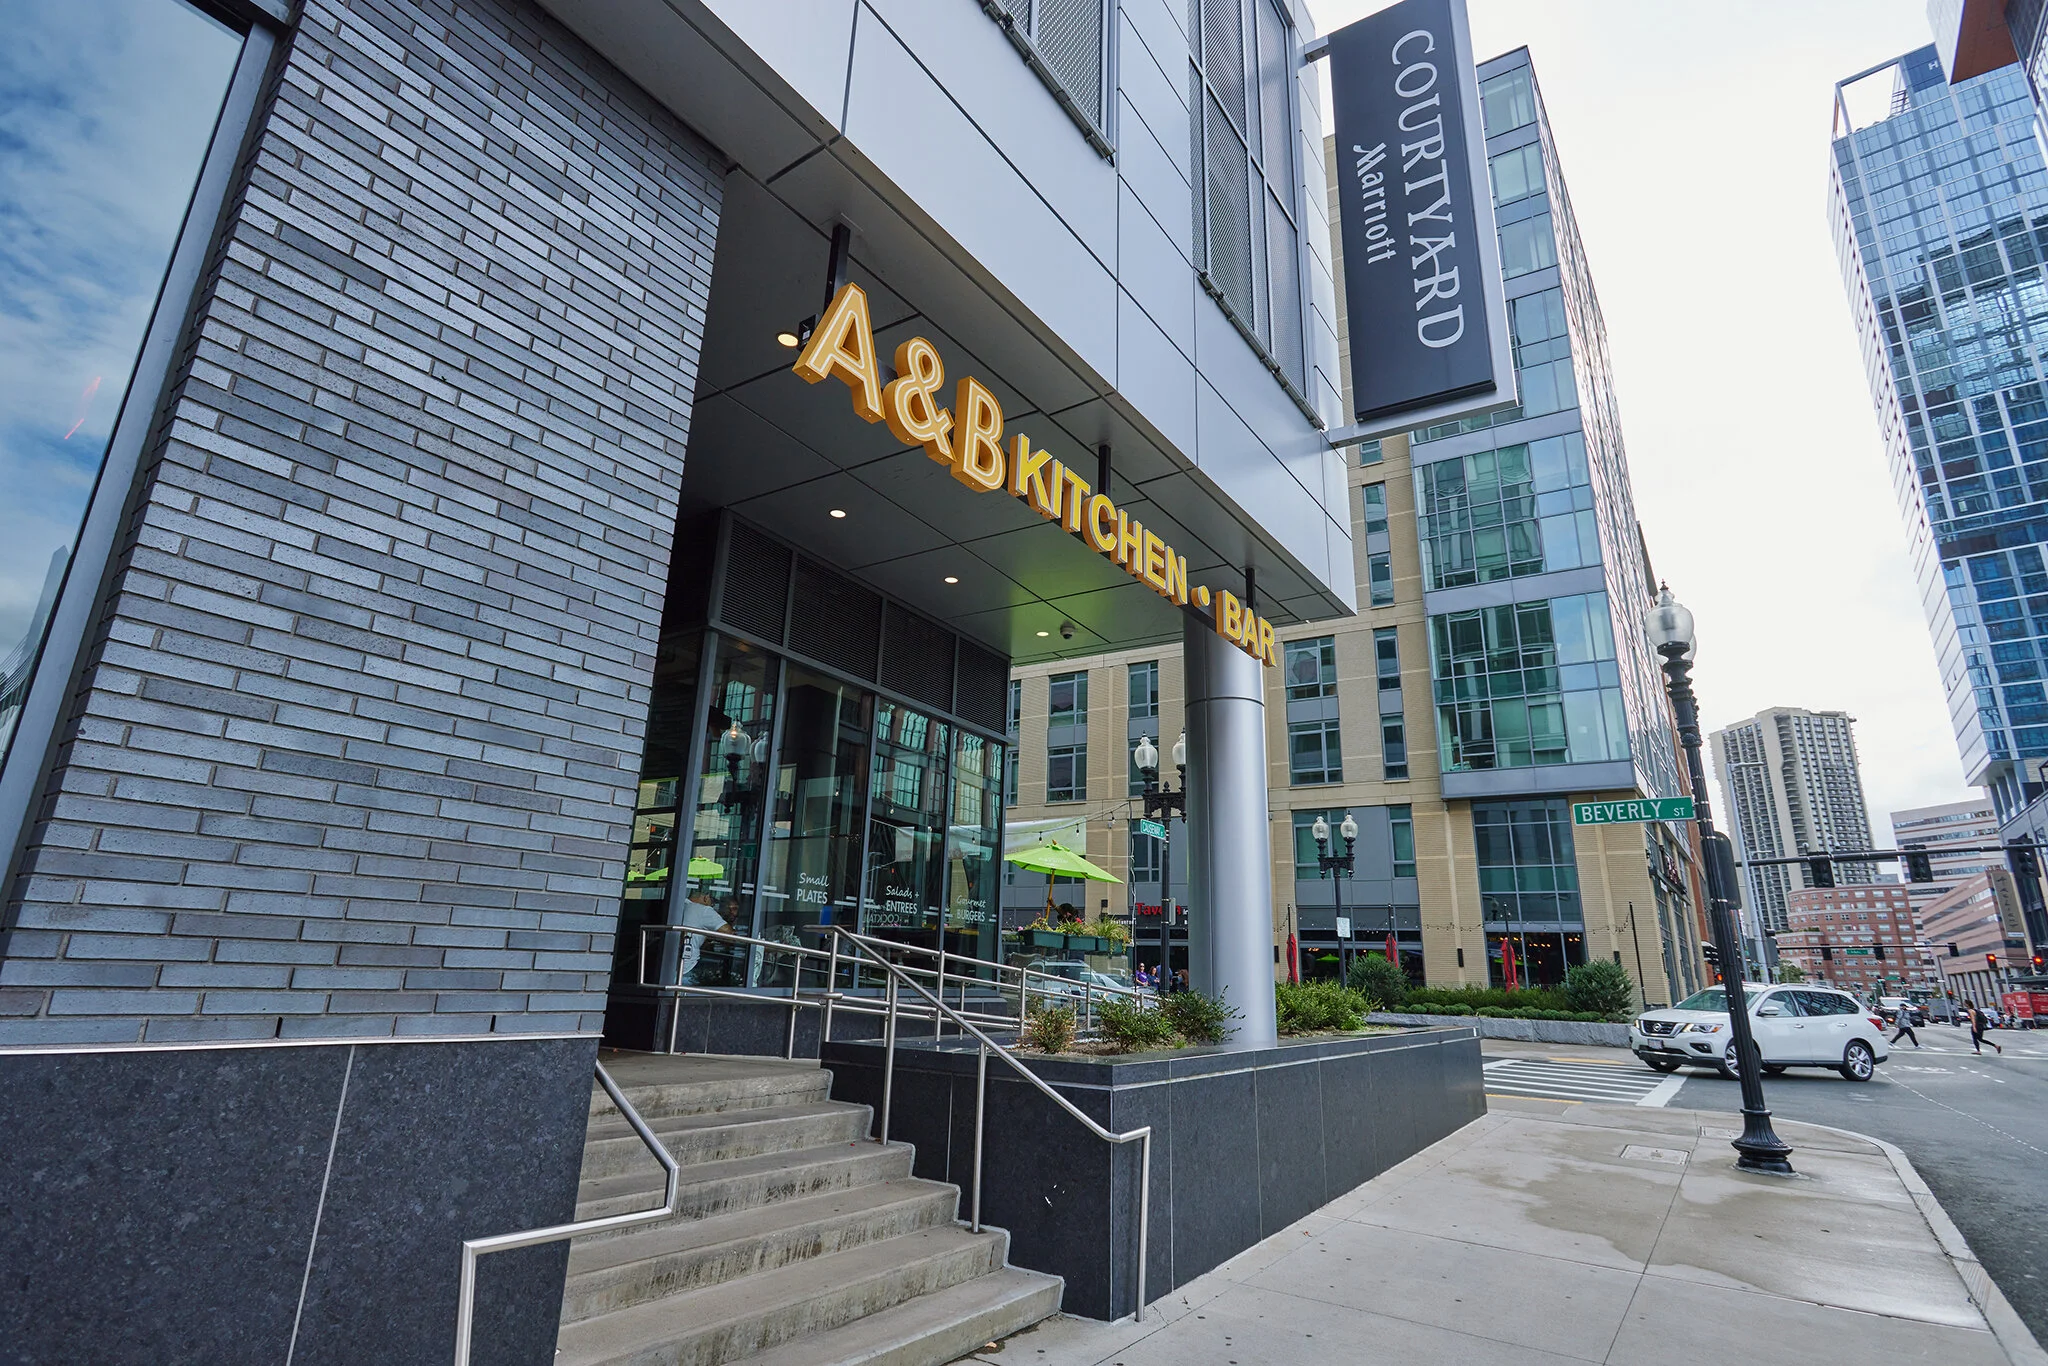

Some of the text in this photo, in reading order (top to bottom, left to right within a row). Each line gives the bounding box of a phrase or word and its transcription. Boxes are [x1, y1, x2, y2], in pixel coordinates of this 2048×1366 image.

[1392, 30, 1465, 348] COURTYARD
[1353, 142, 1396, 264] Marriott
[792, 283, 1277, 667] A&B KITCHEN BAR
[1581, 801, 1685, 822] BEVERLY ST
[799, 872, 829, 887] Small
[796, 888, 828, 904] PLATES
[886, 885, 913, 899] Salads
[886, 900, 918, 914] ENTREES
[957, 894, 987, 908] Gourmet
[957, 909, 986, 922] BURGERS
